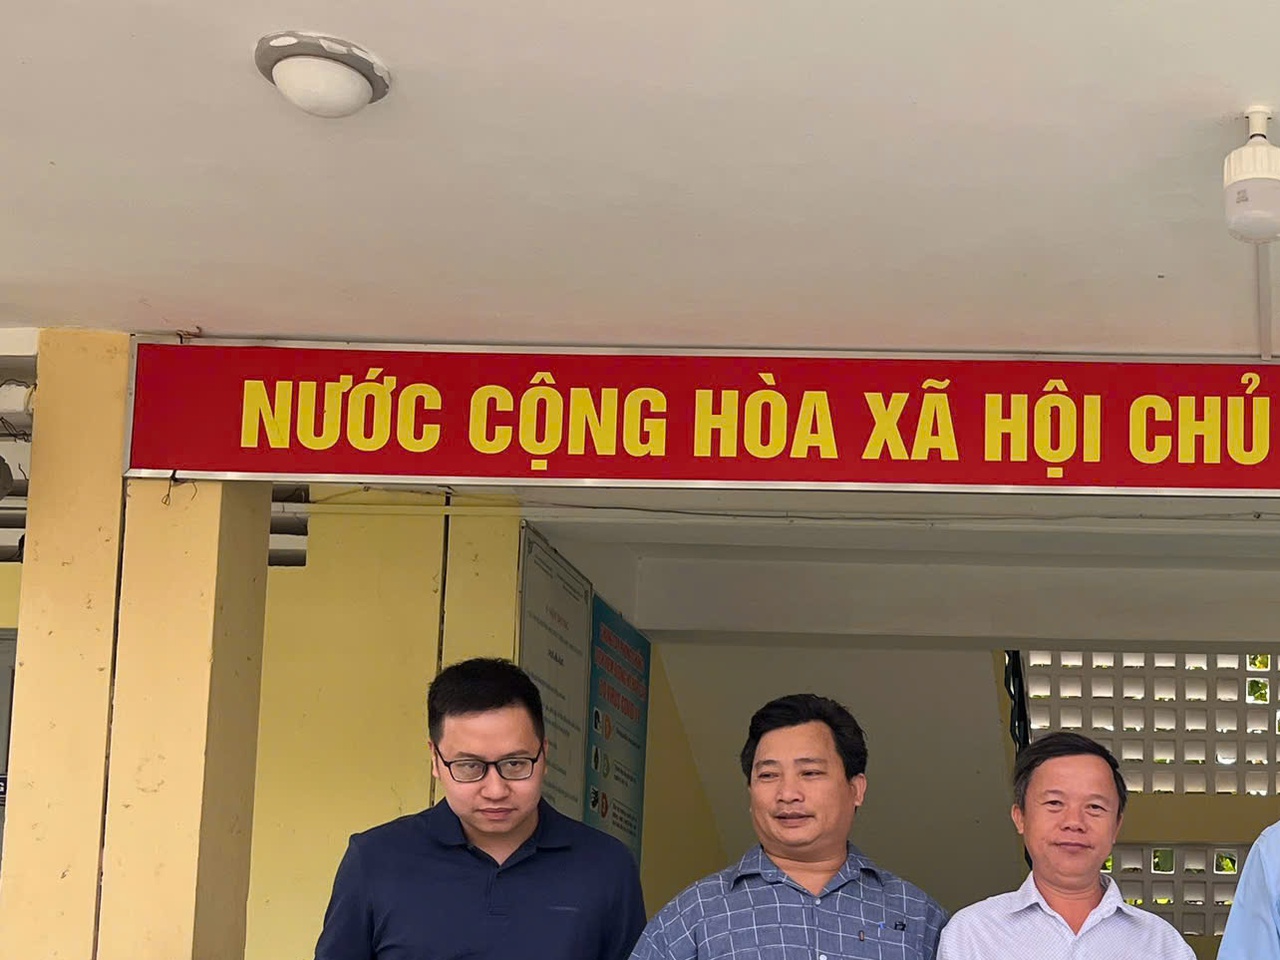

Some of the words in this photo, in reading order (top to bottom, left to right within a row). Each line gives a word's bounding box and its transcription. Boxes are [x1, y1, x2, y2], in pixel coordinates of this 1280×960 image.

[241, 367, 441, 452] NƯỚC
[469, 372, 667, 471] CỘNG
[692, 371, 838, 461] HÒA
[861, 378, 960, 461] XÃ
[984, 381, 1104, 478] HỘI
[1128, 370, 1269, 466] CHỦ
